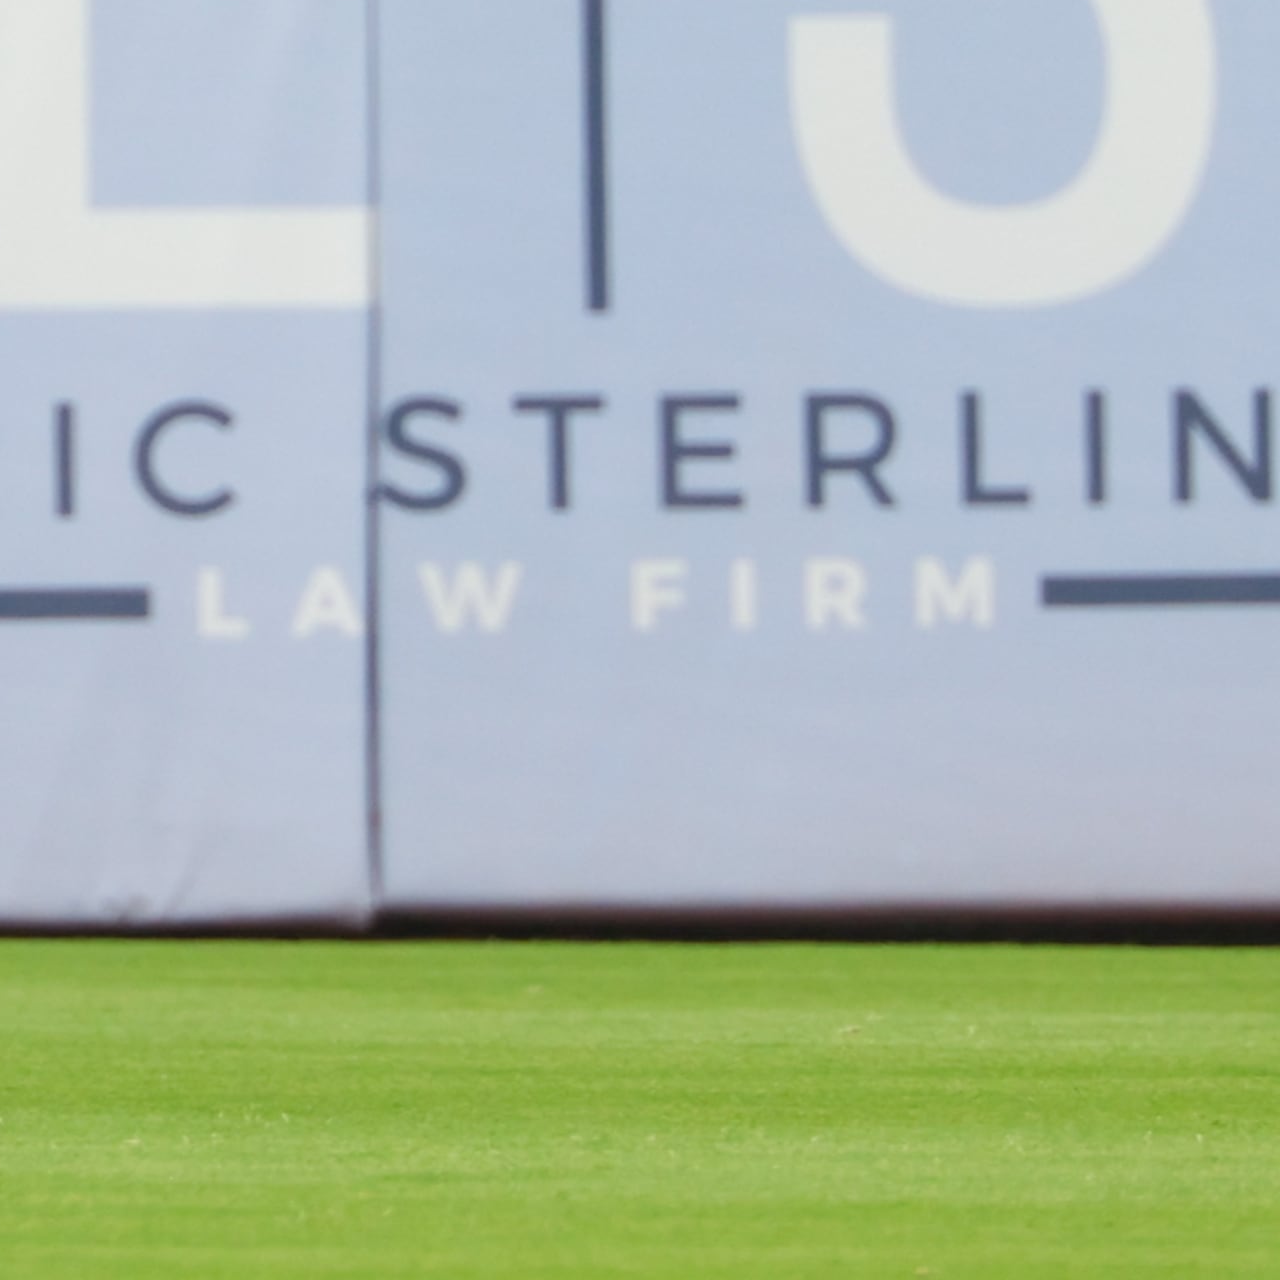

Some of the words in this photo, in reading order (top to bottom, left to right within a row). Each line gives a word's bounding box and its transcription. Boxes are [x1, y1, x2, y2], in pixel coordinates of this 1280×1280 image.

[372, 388, 1274, 511] STERLIN
[196, 559, 524, 641] LAW
[629, 554, 998, 631] FIRM
